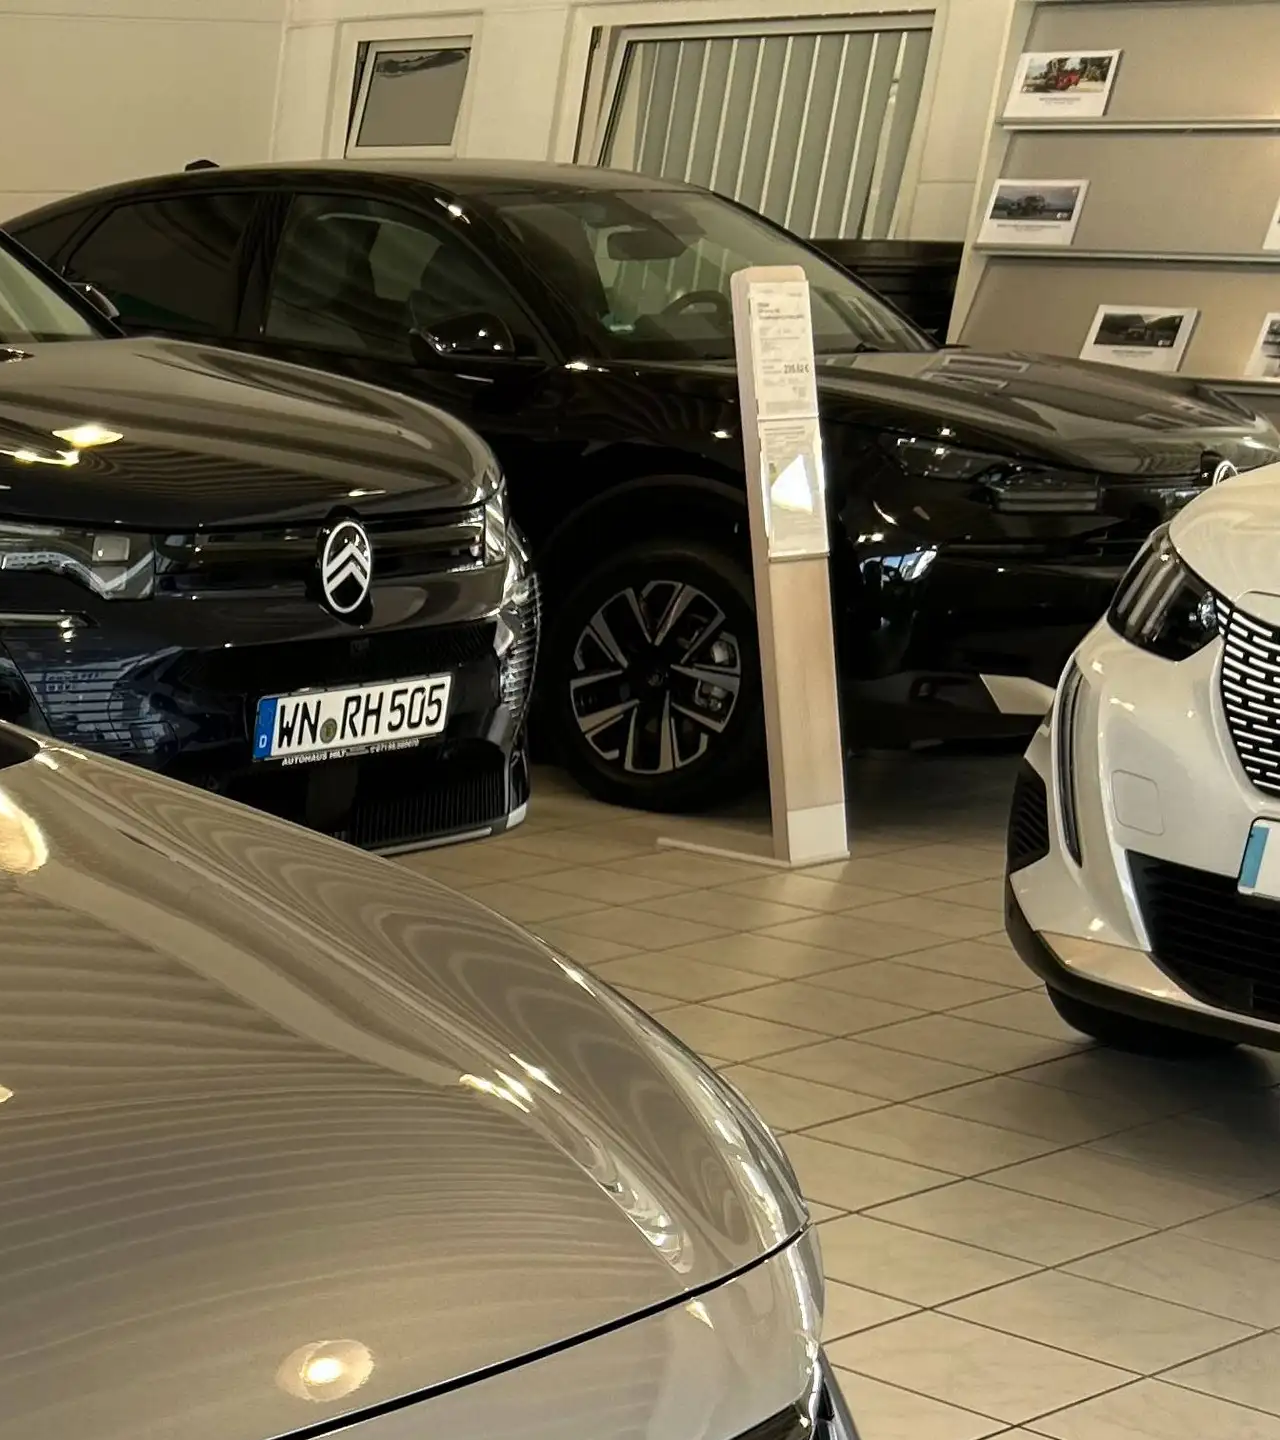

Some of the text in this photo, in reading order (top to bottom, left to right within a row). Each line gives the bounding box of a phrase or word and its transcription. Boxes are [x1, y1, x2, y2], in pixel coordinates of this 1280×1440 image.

[277, 700, 321, 749] WN
[340, 692, 385, 740] RH
[388, 684, 446, 733] 505
